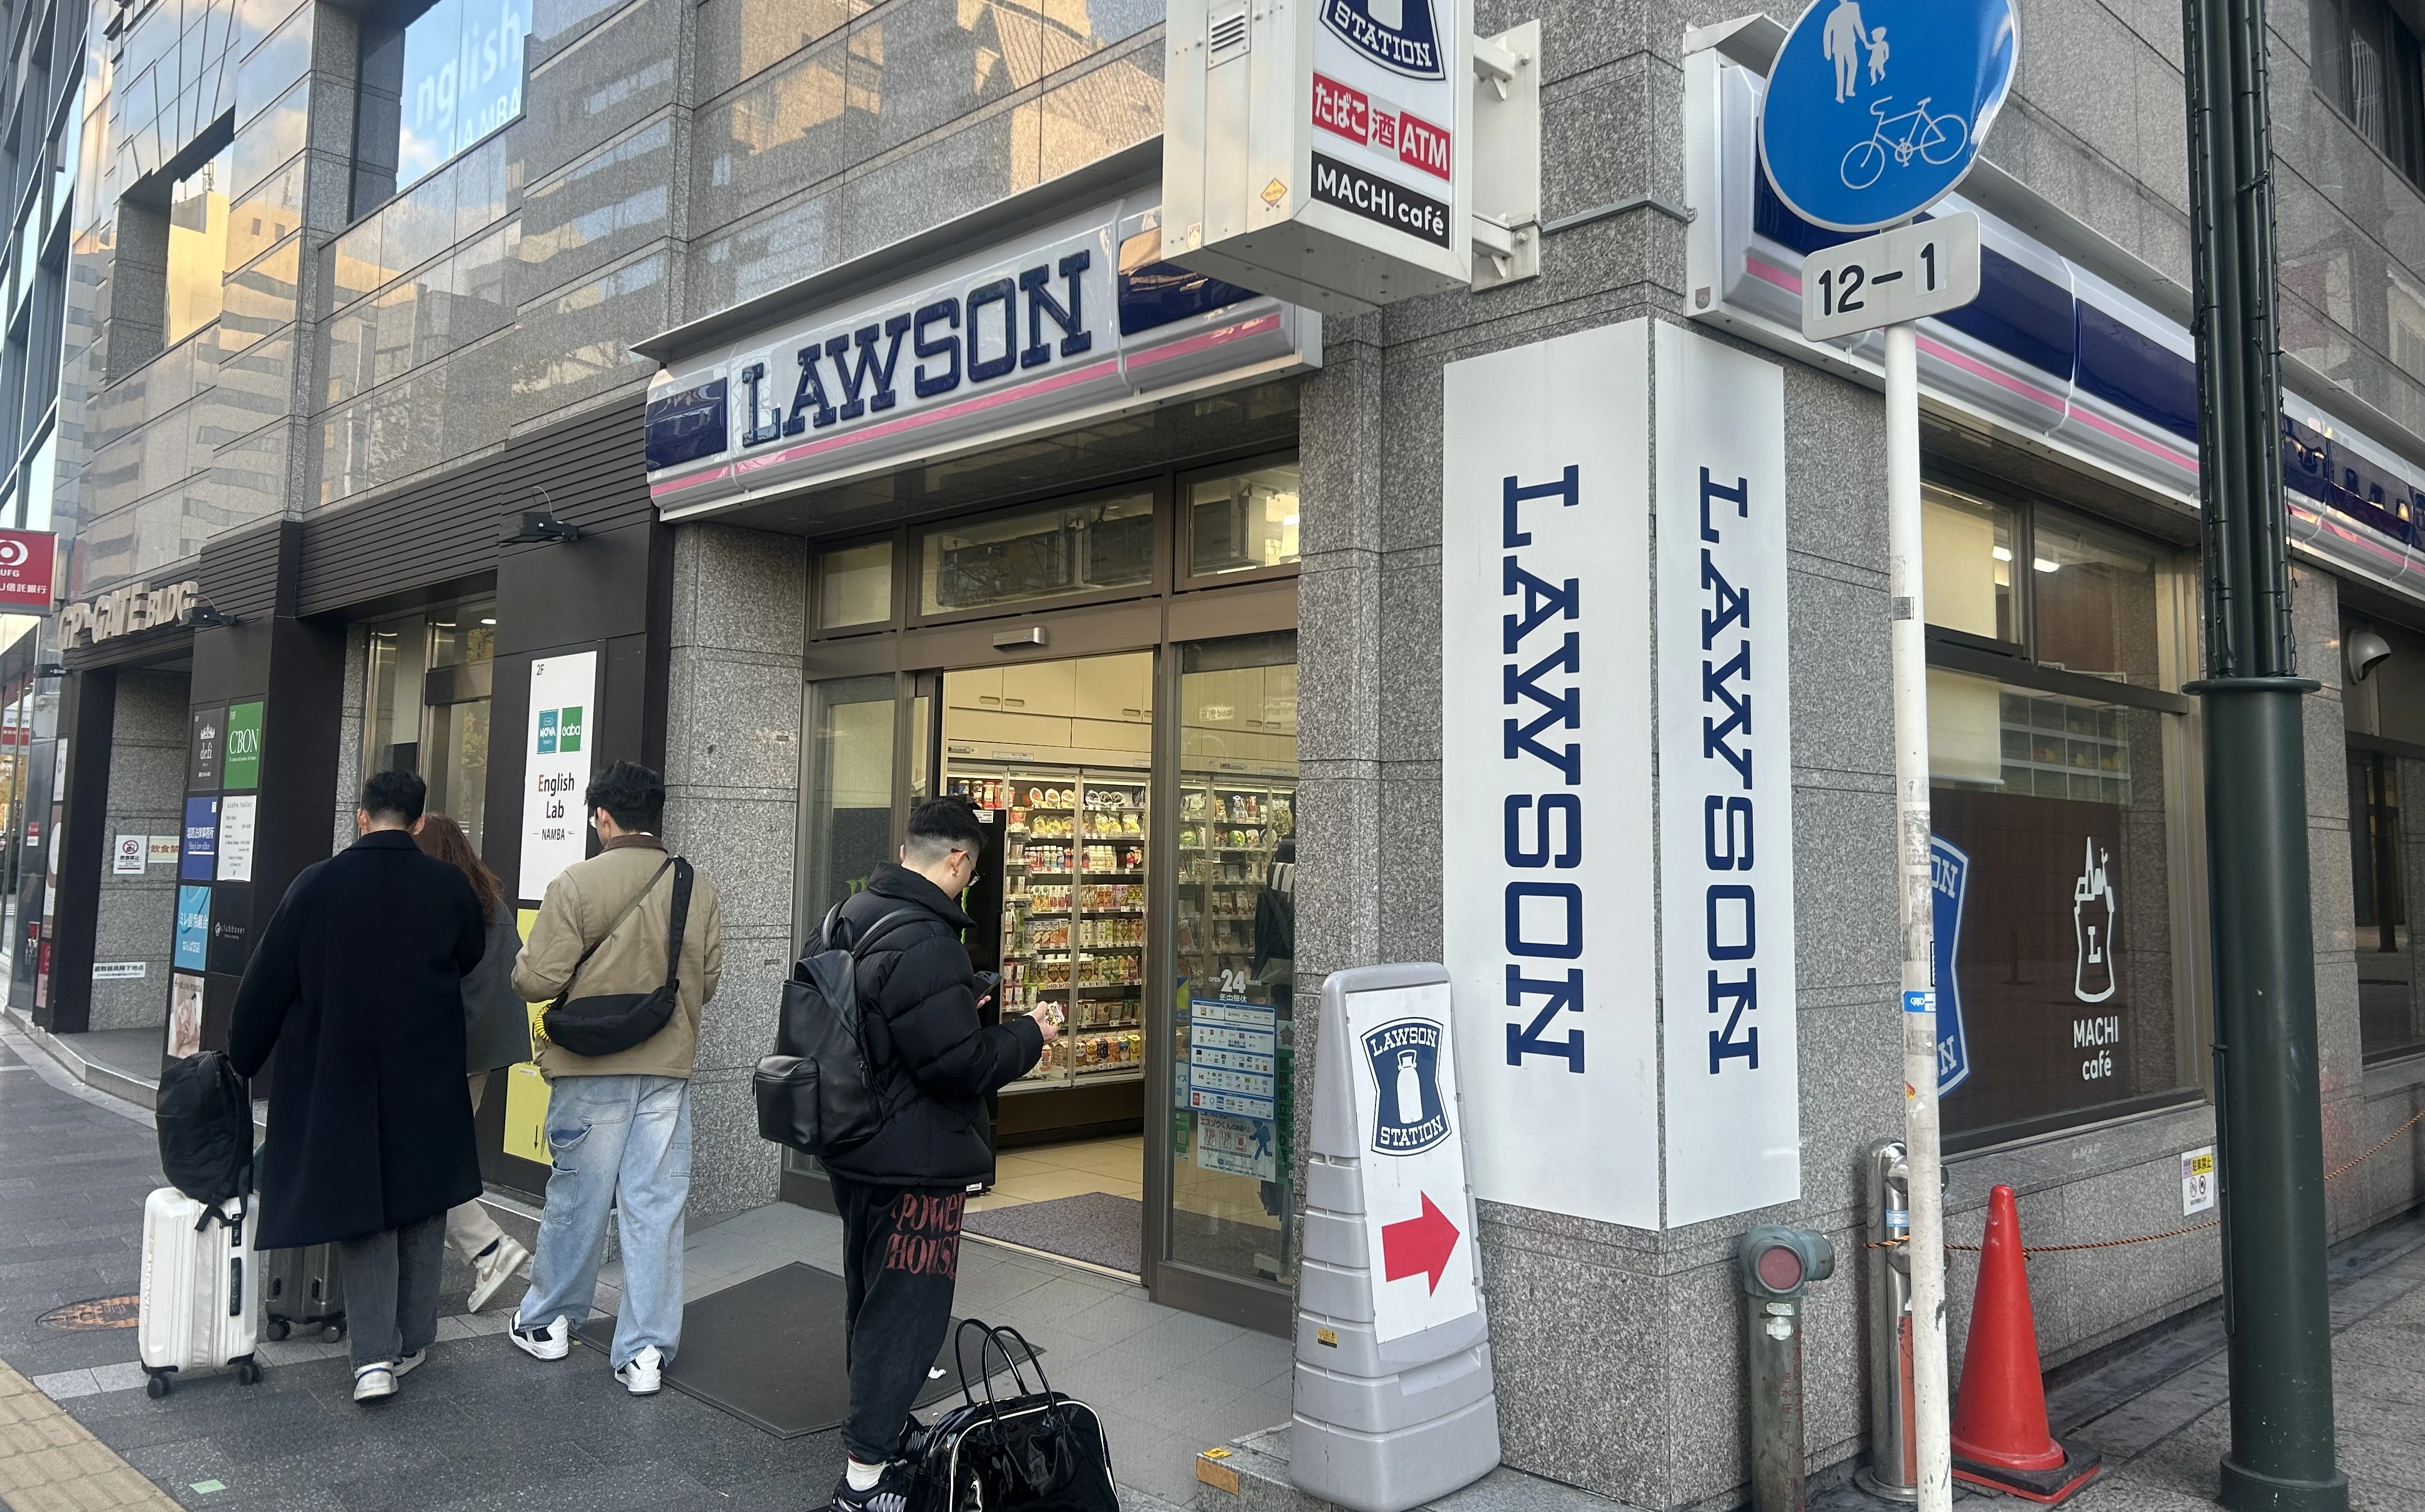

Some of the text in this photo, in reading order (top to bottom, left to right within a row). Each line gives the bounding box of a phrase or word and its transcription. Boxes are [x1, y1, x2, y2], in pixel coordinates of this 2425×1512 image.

[1334, 5, 1433, 68] STATION
[1315, 82, 1448, 171] たばこ 酒 ATM
[1317, 164, 1444, 237] MACHI café
[1818, 242, 1935, 316] 12-1
[742, 248, 1092, 447] LAWSON
[536, 664, 545, 676] 2F
[539, 727, 556, 739] NOVA
[538, 772, 574, 797] English
[1502, 464, 1585, 1074] LAWSON
[1699, 466, 1759, 1075] LAWSON
[546, 800, 564, 819] Lab
[542, 828, 565, 841] NAMBA
[2088, 926, 2101, 963] L
[1219, 992, 1247, 1003] 年中無休
[1220, 969, 1246, 994] 24
[1369, 1027, 1437, 1057] LAWSON
[2073, 1015, 2119, 1048] MACHI
[2082, 1050, 2112, 1081] café
[1380, 1114, 1443, 1146] STATION
